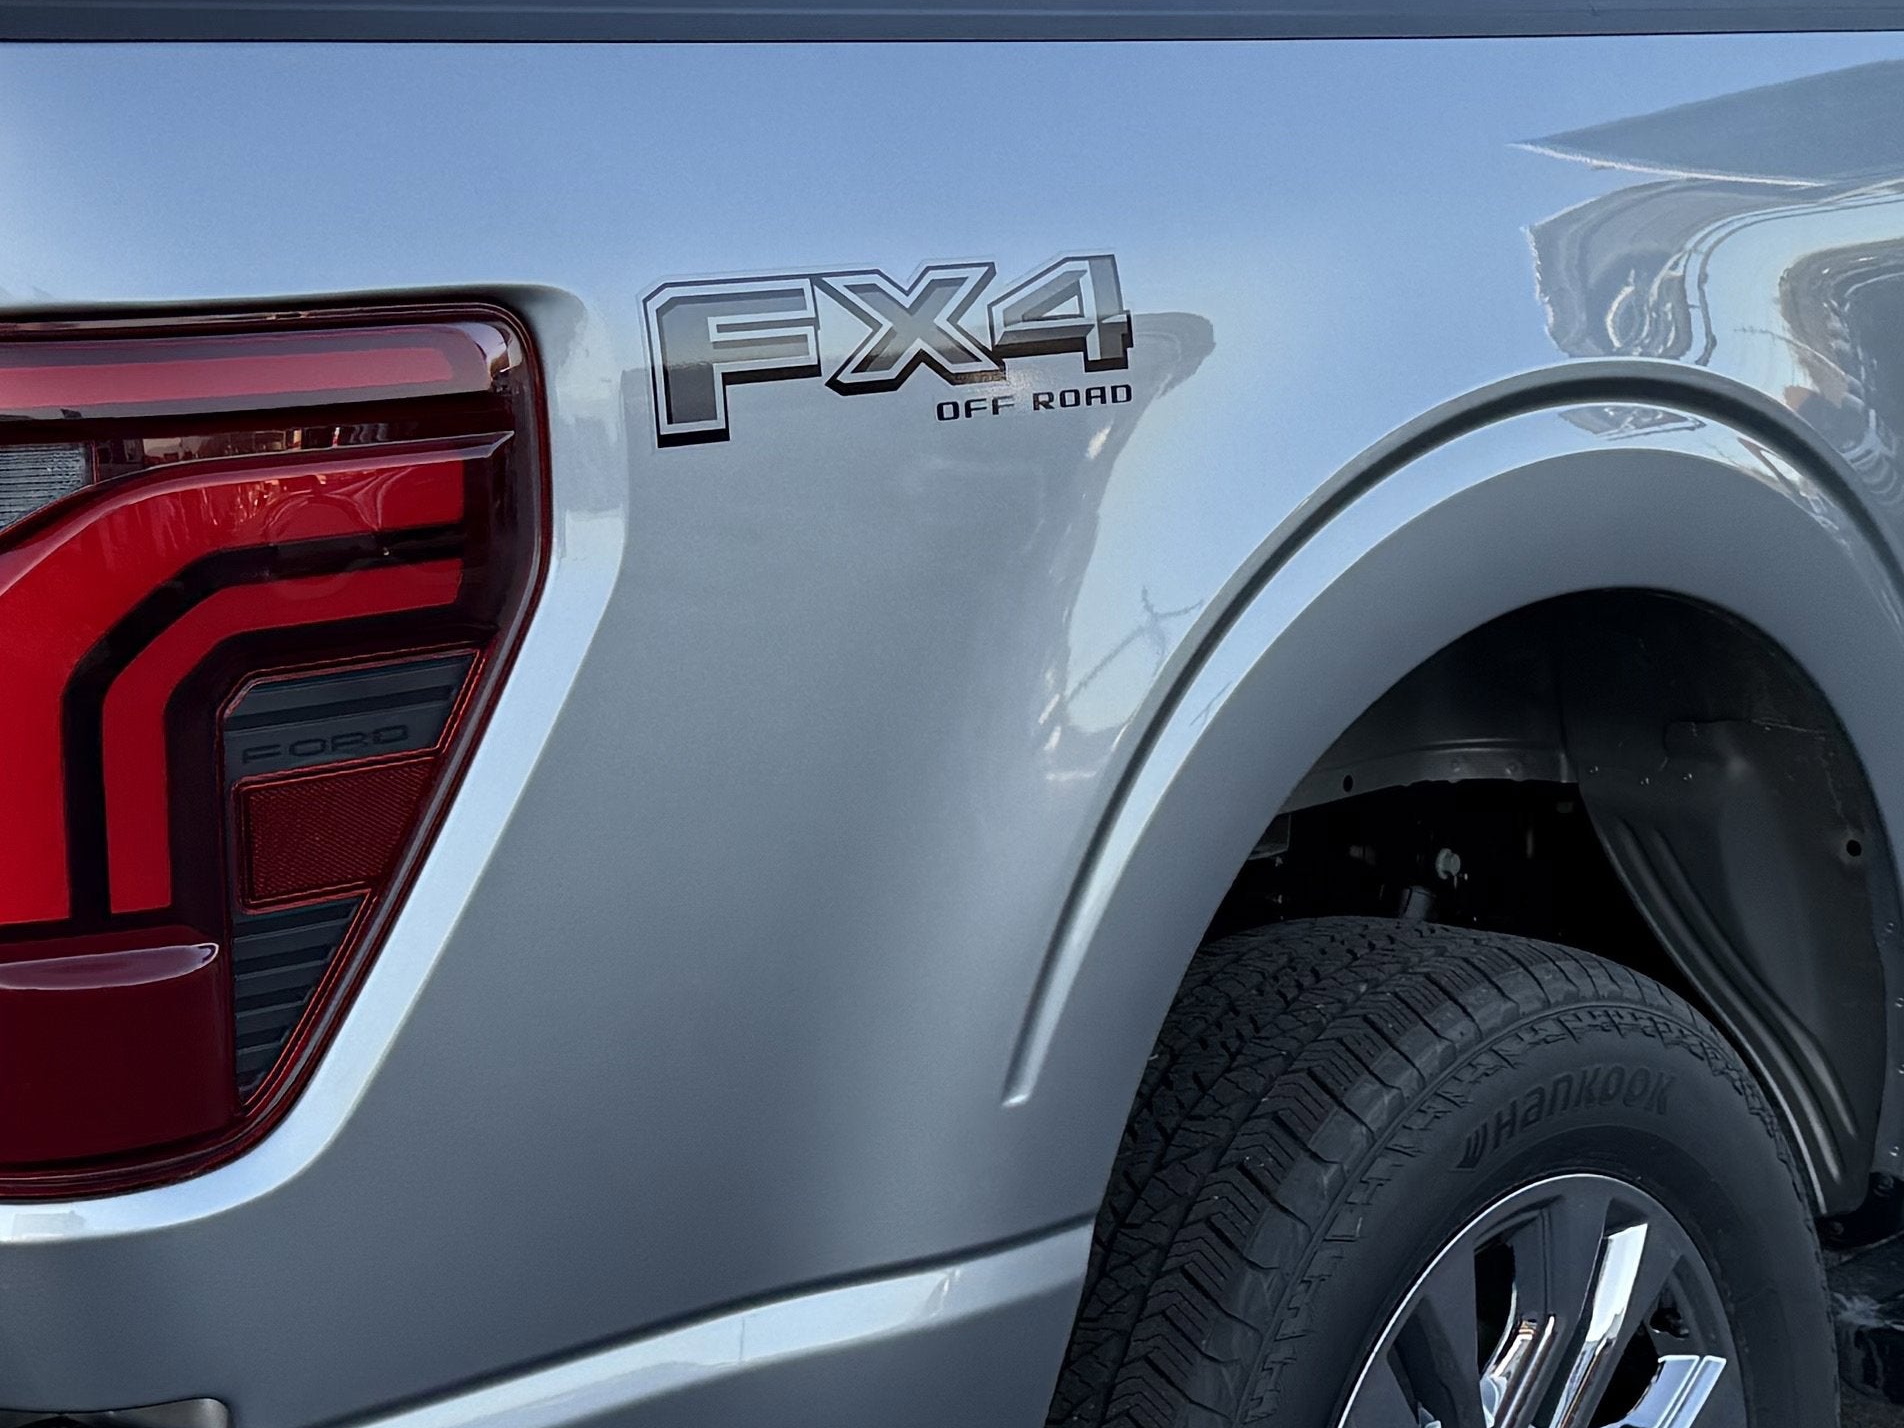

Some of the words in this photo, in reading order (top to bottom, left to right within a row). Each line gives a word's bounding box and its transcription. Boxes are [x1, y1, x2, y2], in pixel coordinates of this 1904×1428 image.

[642, 252, 1133, 449] FX4
[936, 395, 1018, 421] OFF
[1032, 383, 1132, 412] ROAD
[242, 724, 409, 764] FORD
